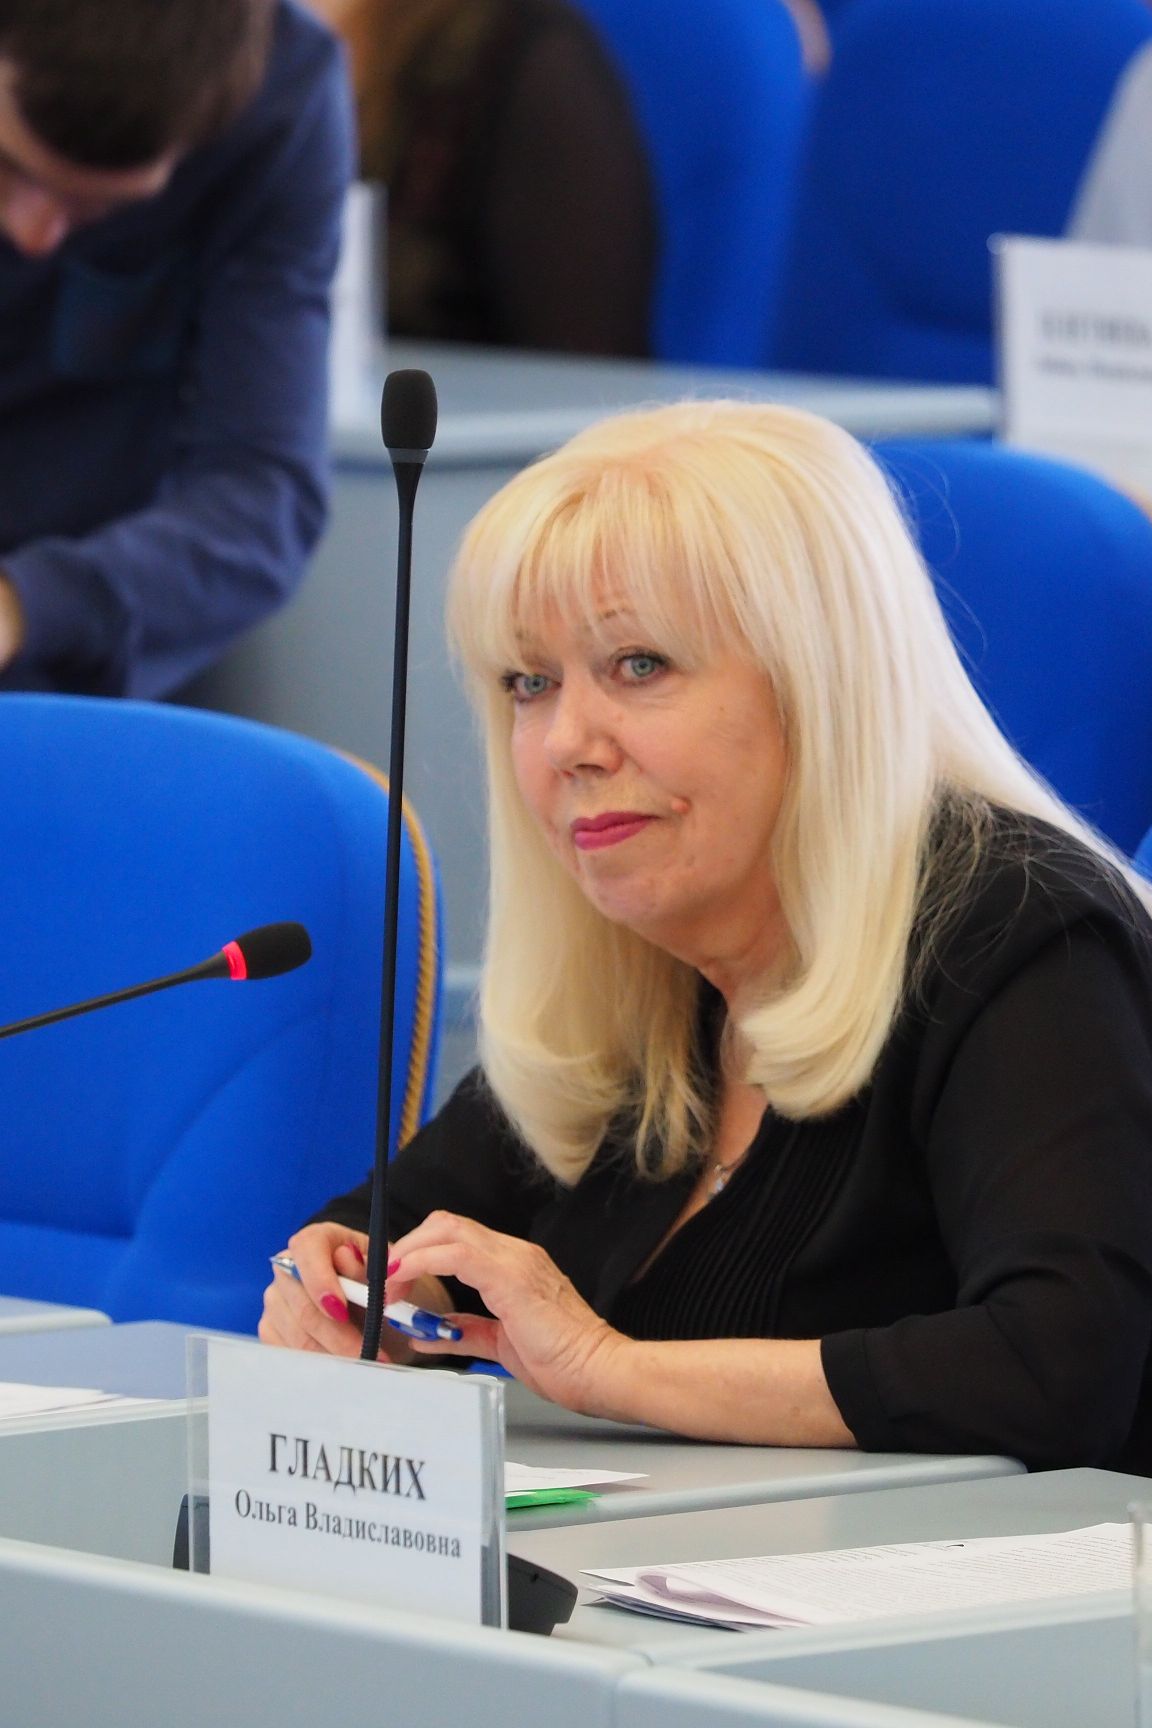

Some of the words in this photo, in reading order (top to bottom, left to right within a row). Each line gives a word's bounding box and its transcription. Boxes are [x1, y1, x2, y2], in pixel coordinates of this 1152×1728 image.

[268, 1433, 427, 1501] ГЛАДКИХ
[234, 1489, 298, 1527] Ольга
[304, 1502, 462, 1559] Владиславовна
